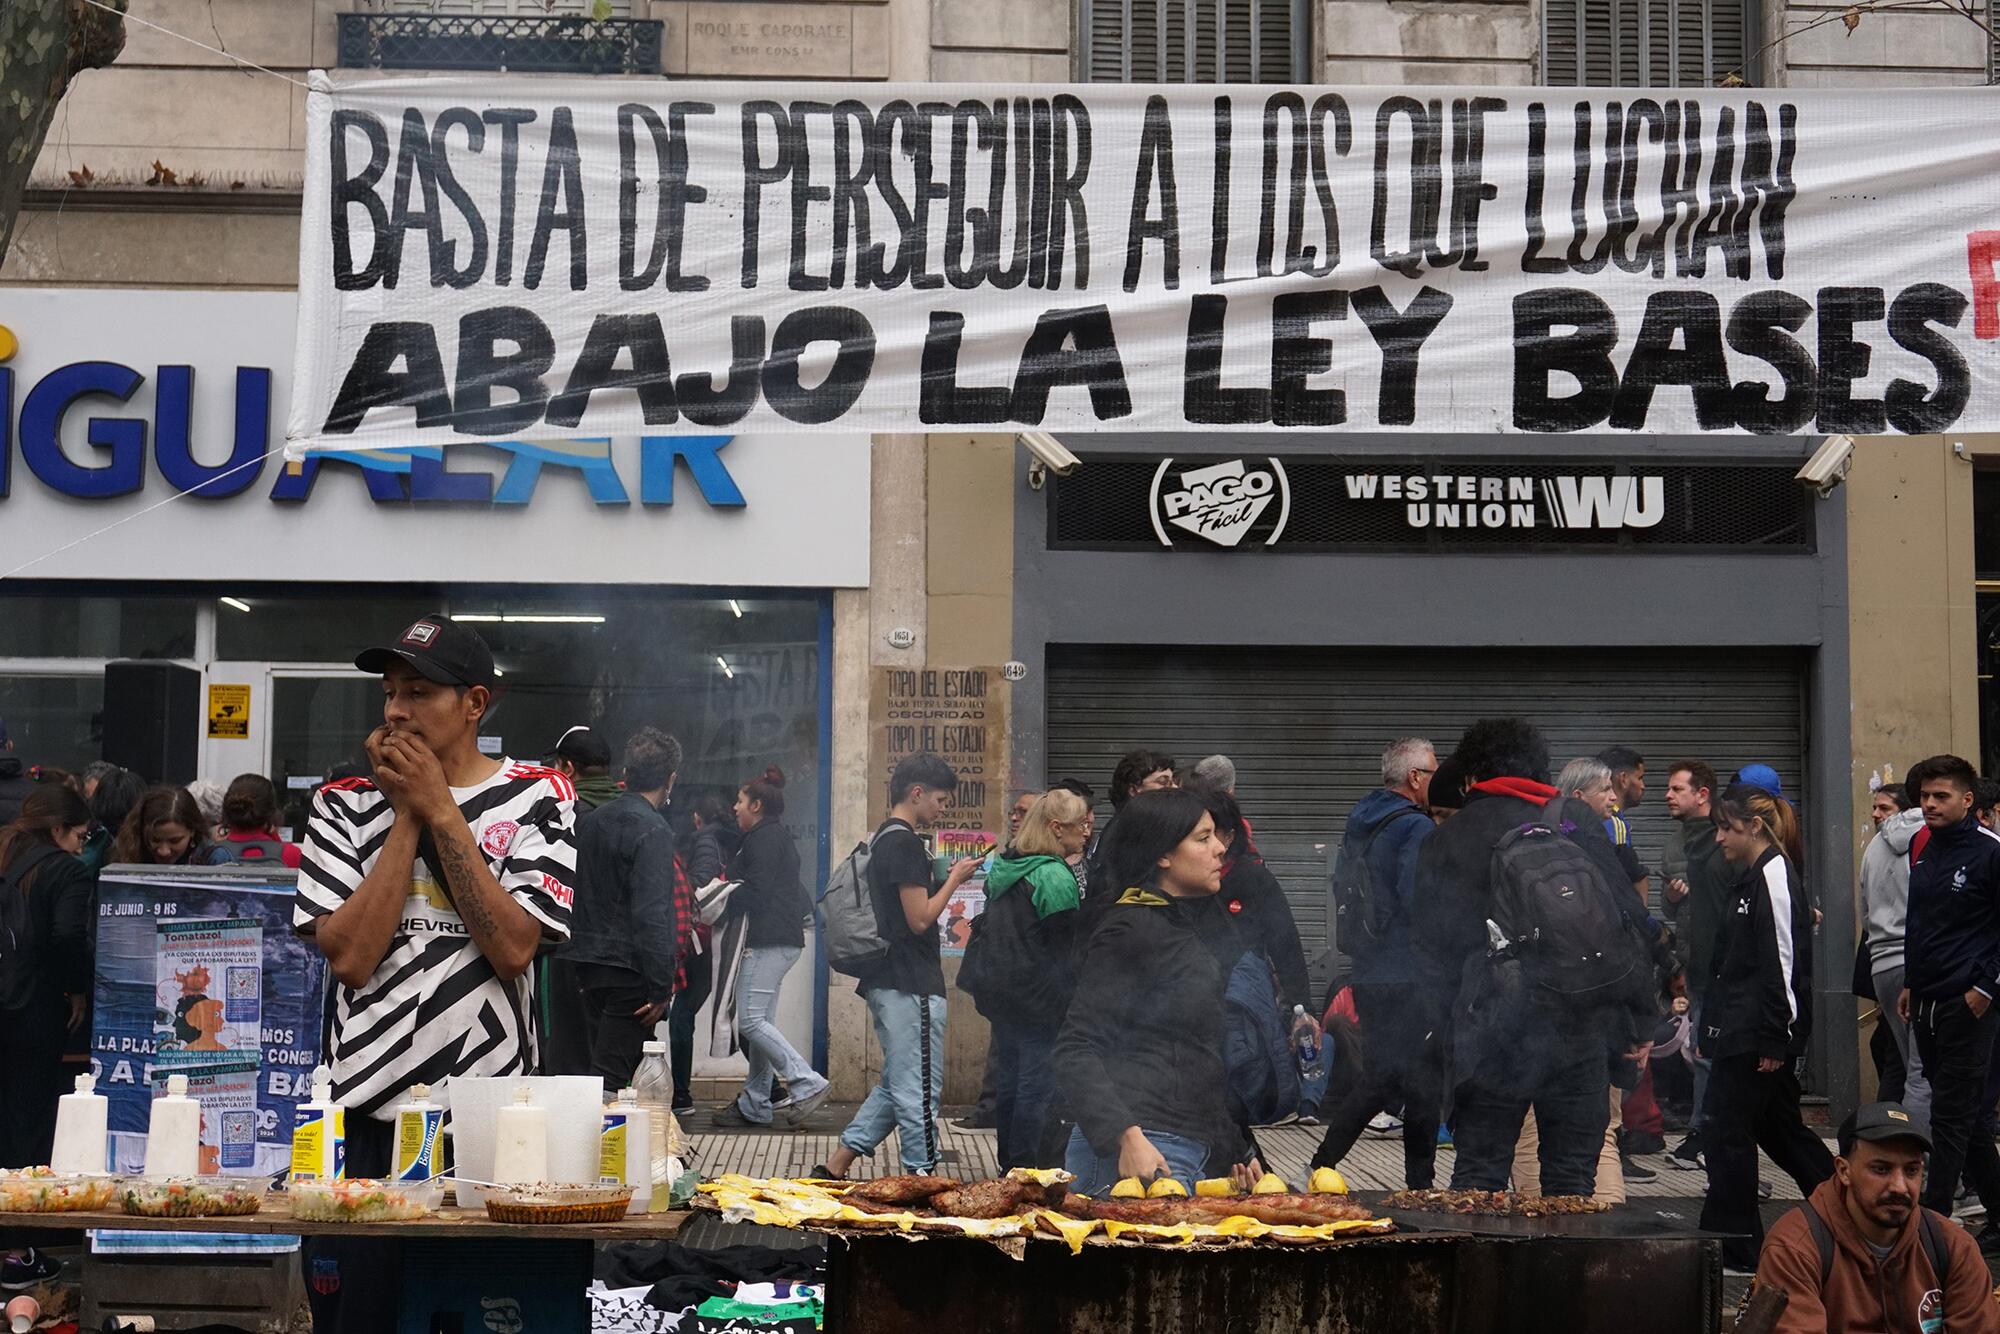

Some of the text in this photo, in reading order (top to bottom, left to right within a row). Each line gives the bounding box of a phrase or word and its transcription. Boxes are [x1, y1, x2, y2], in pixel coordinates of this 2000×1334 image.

[330, 91, 1798, 292] BASTA DE PERSEGUIR A LOS QUE LUCHAN
[322, 304, 877, 436] ABAJO
[918, 303, 1132, 425] LA
[1183, 285, 1454, 427] LEY
[1512, 282, 1972, 436] BASES
[1163, 471, 1274, 518] PAGO
[1345, 475, 1533, 500] WESTERN
[1197, 502, 1253, 533] Fácil
[1407, 503, 1535, 528] UNION
[887, 670, 987, 697] TOPO DEL ESTADO
[1003, 664, 1025, 678] 1649
[885, 726, 987, 752] TOPO DEL ESTADO
[100, 904, 113, 916] DE
[115, 903, 143, 916] JUNIO
[154, 903, 160, 916] 9
[163, 903, 177, 915] HS
[400, 918, 468, 934] HEVRO
[98, 1035, 157, 1054] LA PLAZ
[261, 1028, 294, 1045] MOS
[418, 1120, 437, 1167] Benidorm
